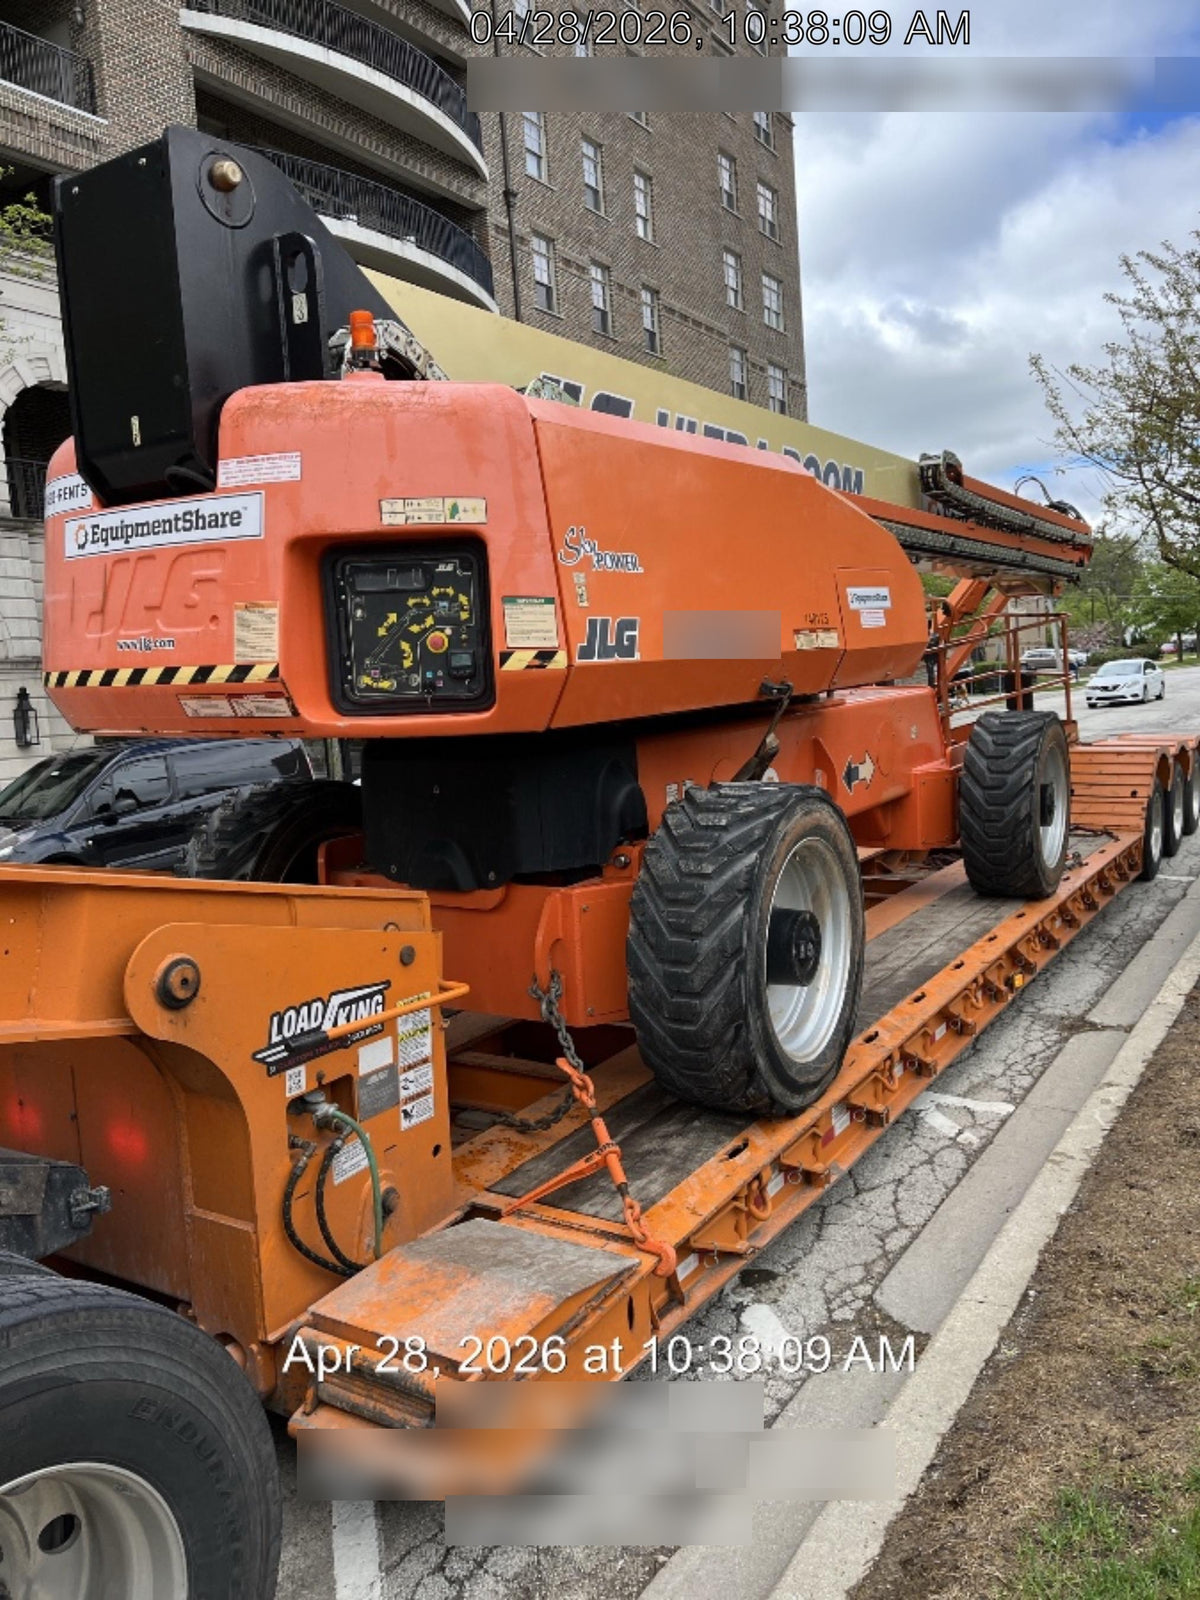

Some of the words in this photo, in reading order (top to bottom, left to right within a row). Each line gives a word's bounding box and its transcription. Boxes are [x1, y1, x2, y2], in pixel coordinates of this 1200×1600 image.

[90, 507, 243, 547] EquipmentShare
[576, 617, 639, 661] JLG
[270, 1000, 325, 1044] LOAD
[337, 994, 384, 1027] KING
